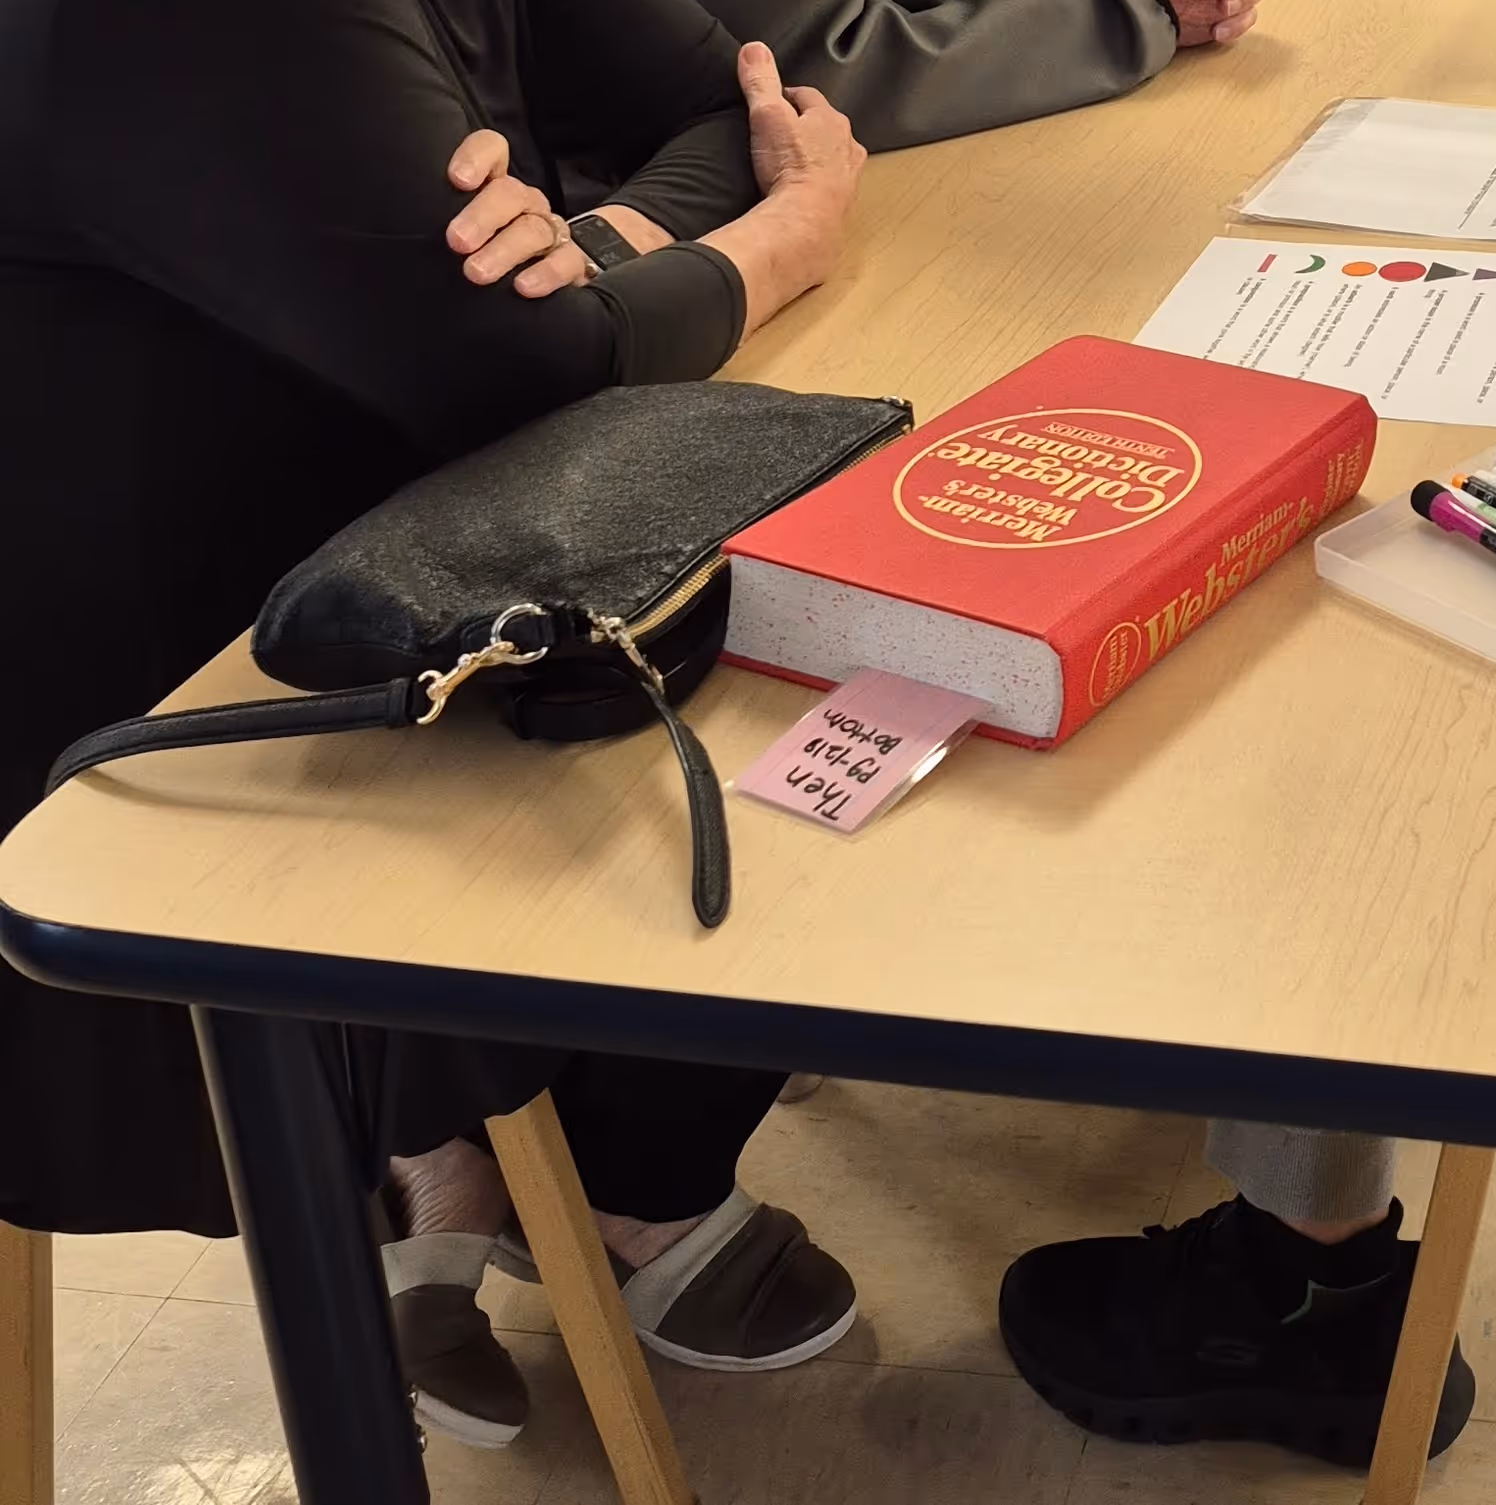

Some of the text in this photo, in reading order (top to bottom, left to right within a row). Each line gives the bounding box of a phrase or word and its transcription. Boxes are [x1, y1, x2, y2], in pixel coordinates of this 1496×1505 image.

[927, 441, 1166, 514] Collegiate
[977, 424, 1184, 488] Dictionary
[917, 493, 1062, 543] Merriam-
[943, 478, 1078, 526] Webster's
[1220, 501, 1296, 568] Merriam-
[823, 708, 903, 755] Bottom
[786, 765, 852, 821] Then
